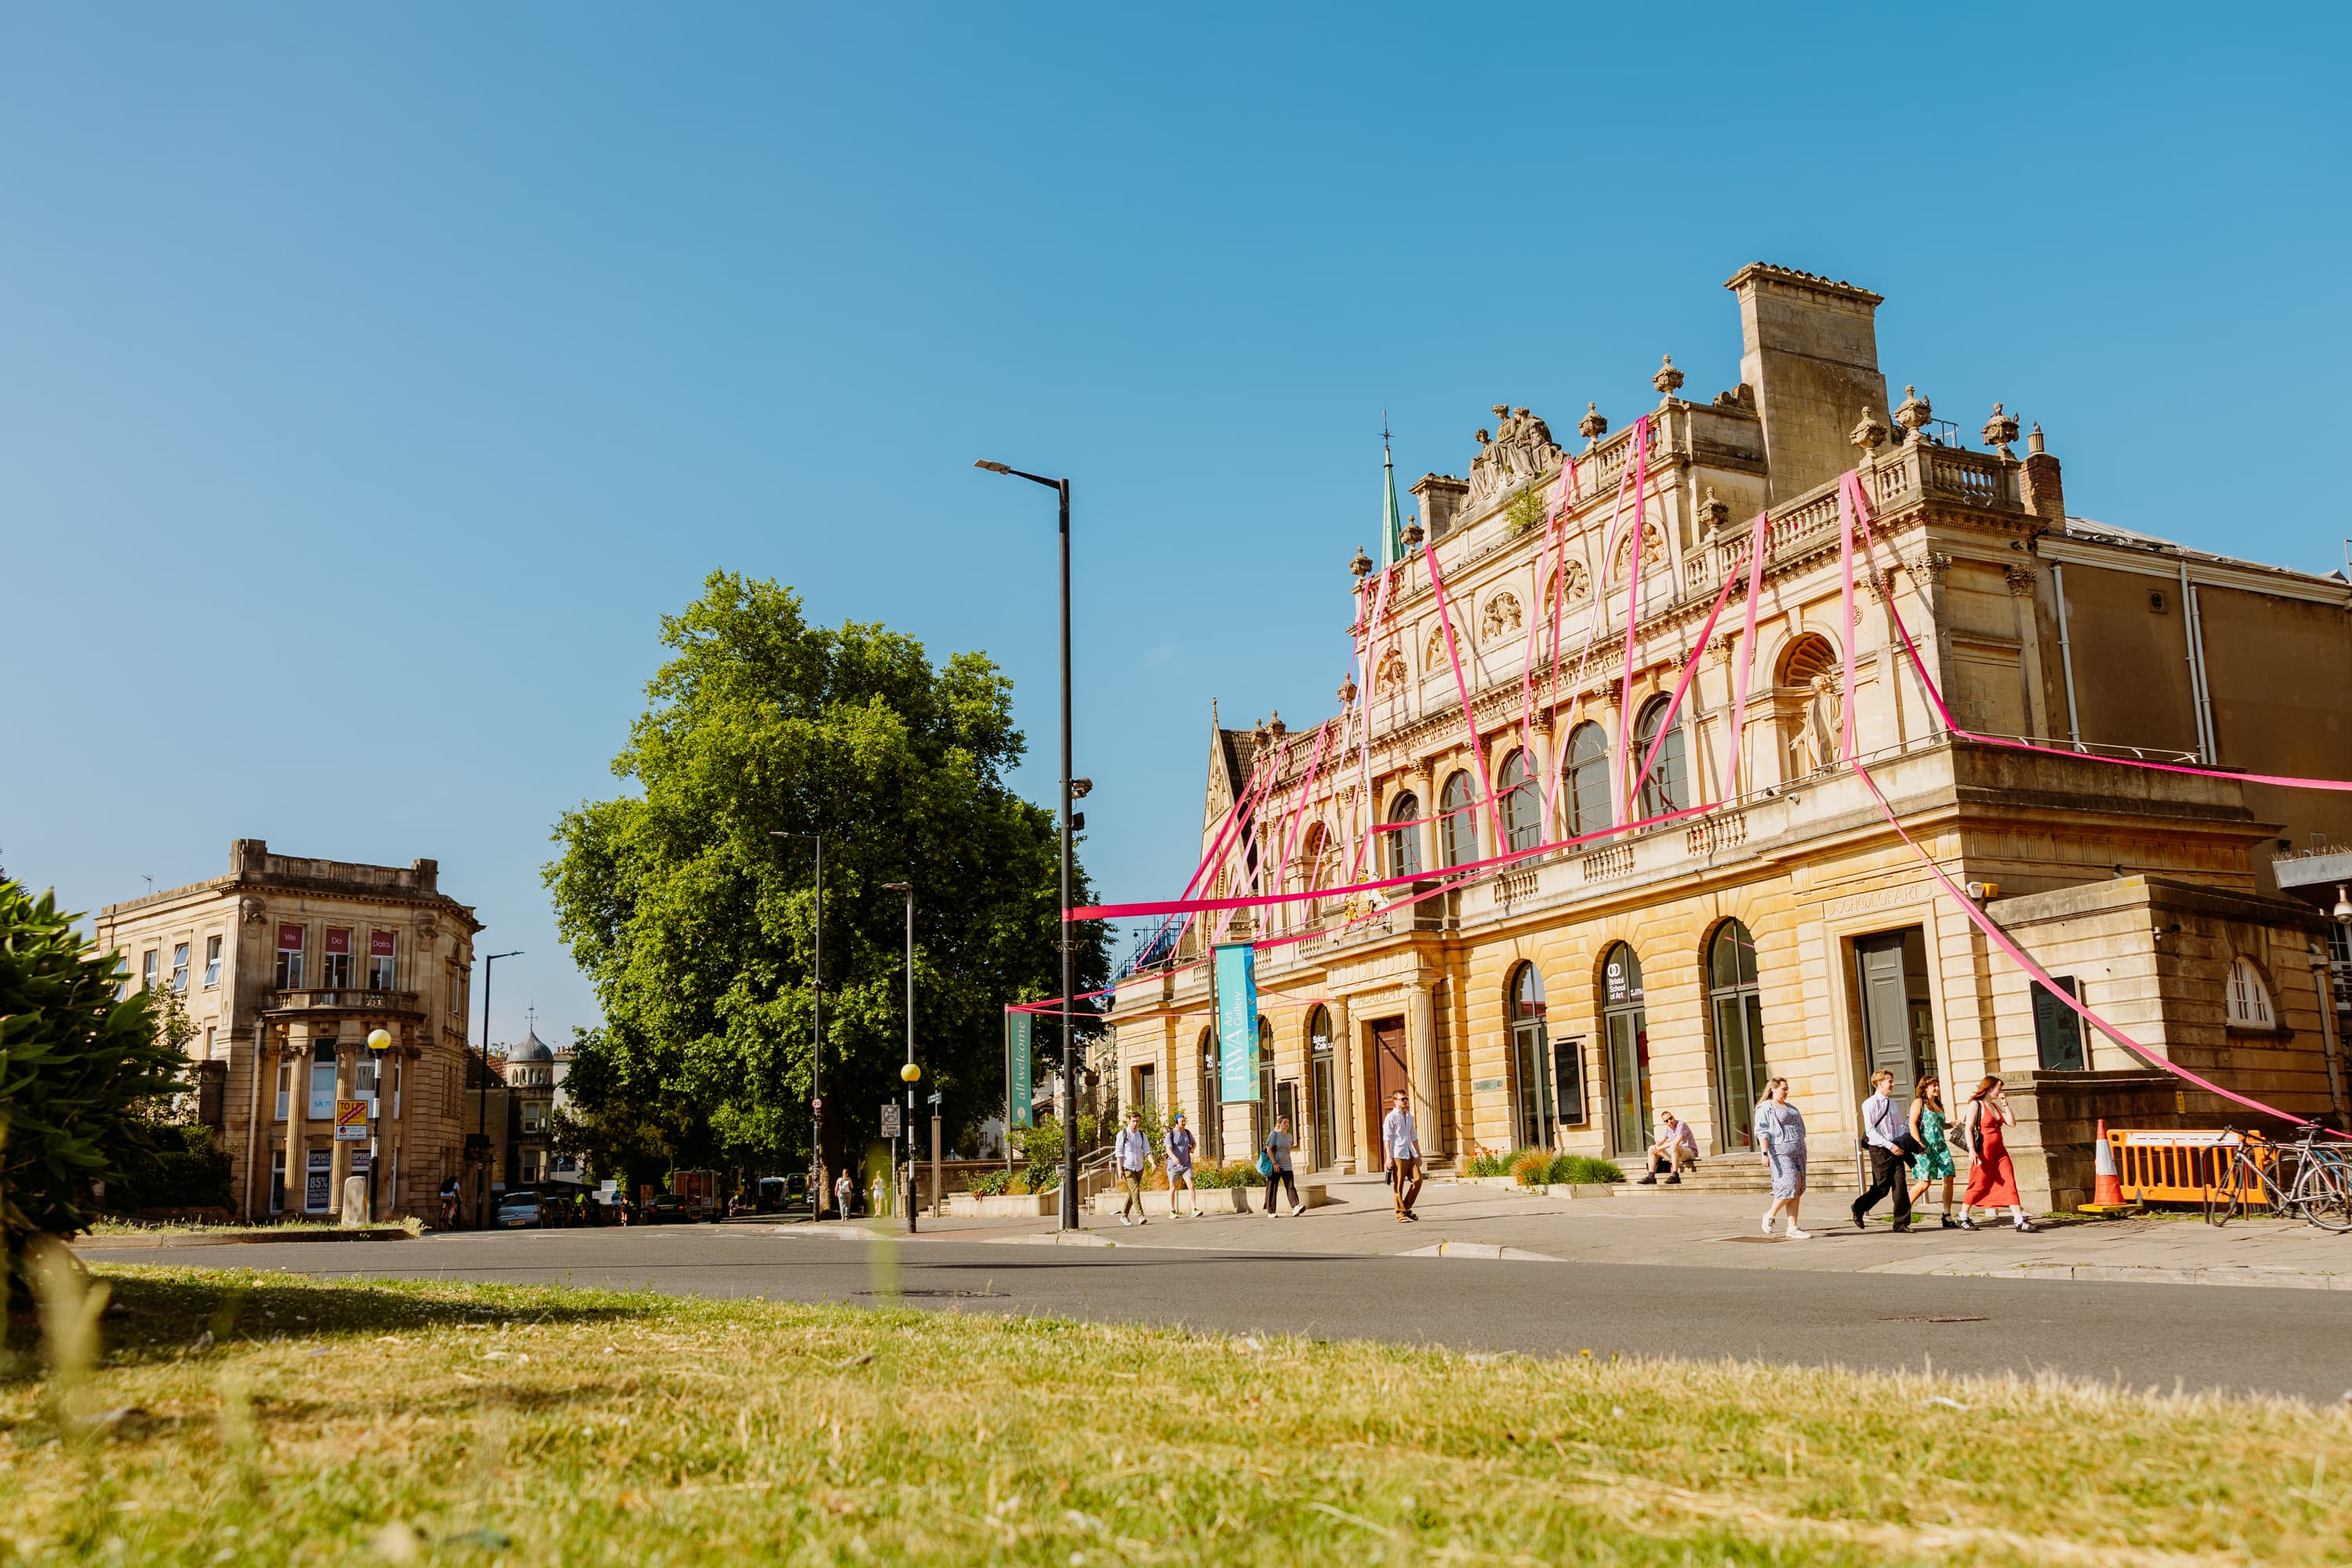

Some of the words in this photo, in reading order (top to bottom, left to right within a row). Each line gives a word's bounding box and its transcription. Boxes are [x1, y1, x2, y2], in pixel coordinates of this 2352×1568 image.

[1878, 891, 1893, 906] OF
[1893, 885, 1920, 902] ART
[1609, 977, 1624, 985] Bristol
[1610, 984, 1625, 993] School
[1358, 987, 1401, 1006] ACADEMY
[1233, 991, 1244, 1026] Gallery
[1223, 1011, 1232, 1026] Art
[1015, 1022, 1026, 1080] welcome
[1225, 1028, 1245, 1080] RWA
[1016, 1083, 1025, 1100] all
[310, 1177, 328, 1189] 85%
